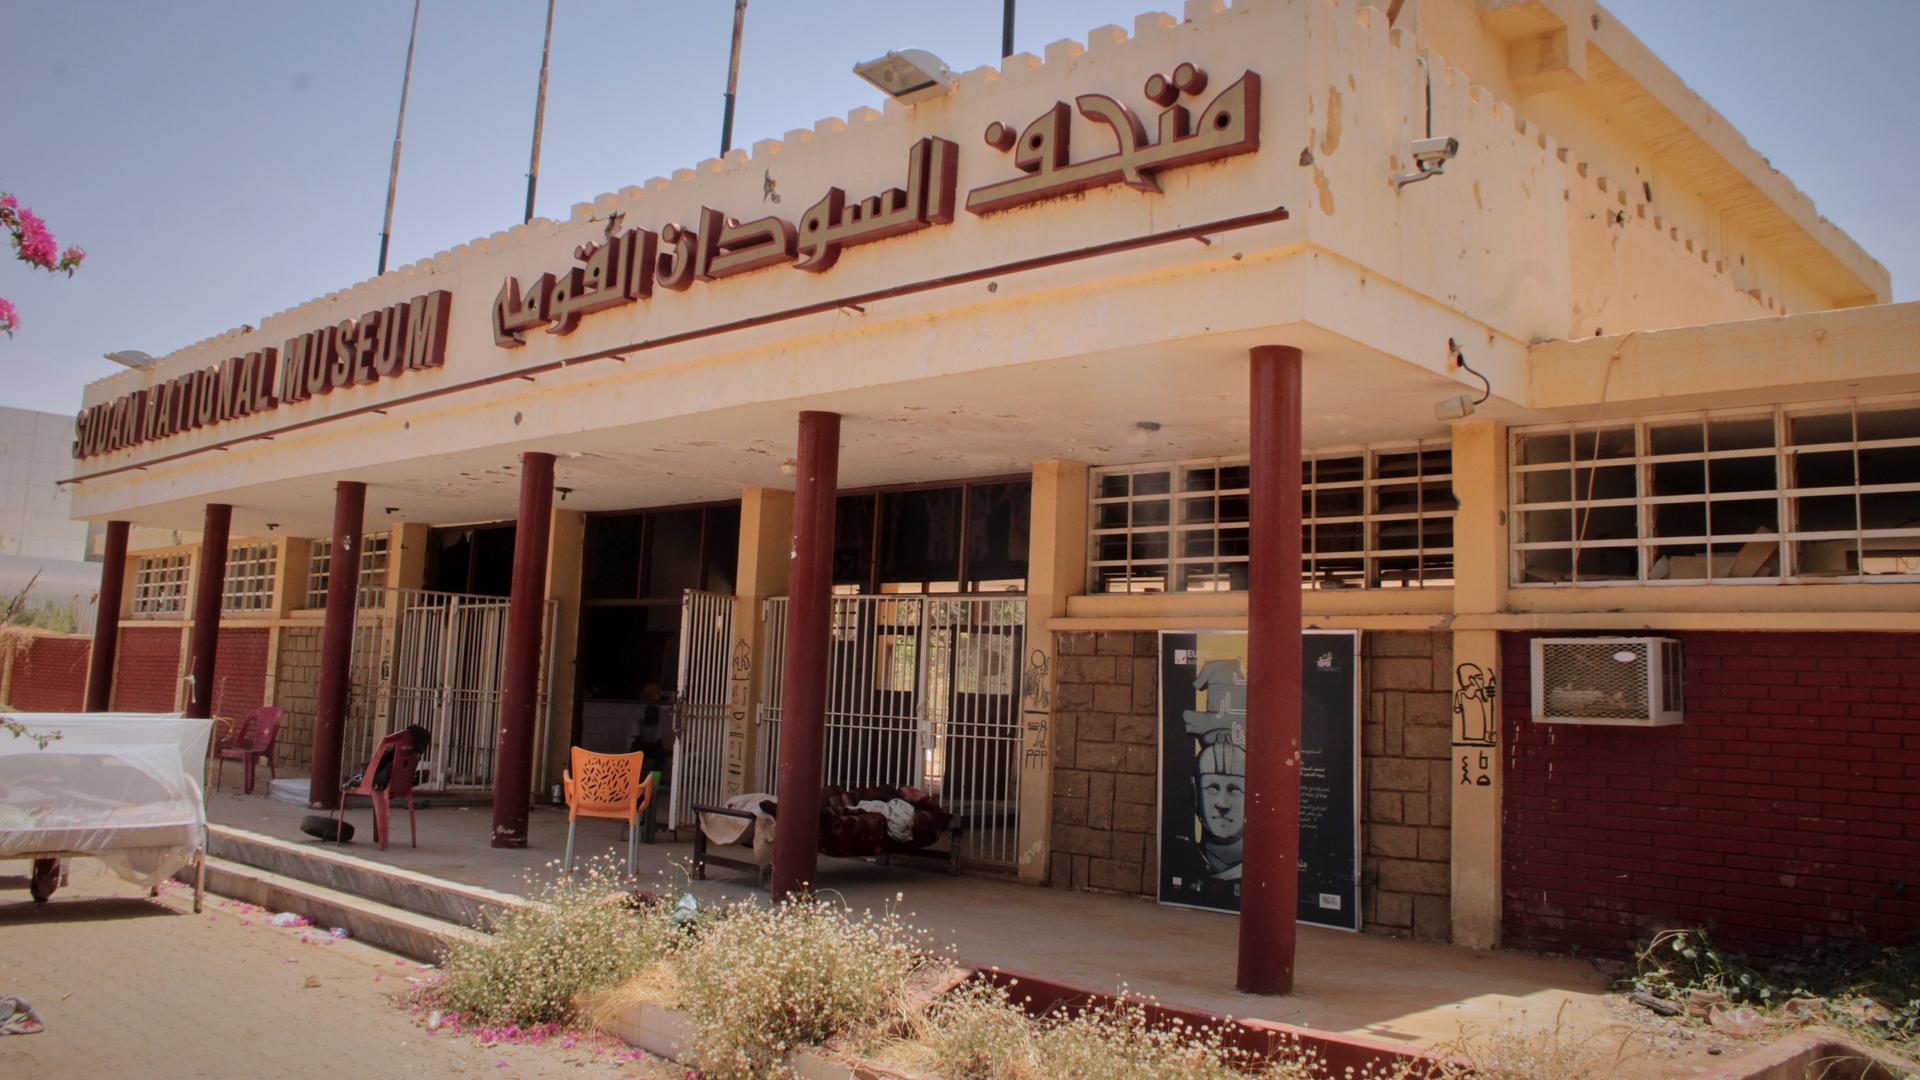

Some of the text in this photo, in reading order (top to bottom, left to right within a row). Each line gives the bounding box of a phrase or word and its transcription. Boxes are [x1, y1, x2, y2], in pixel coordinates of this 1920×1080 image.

[656, 136, 957, 292] السودان
[965, 62, 1261, 216] متحف
[72, 289, 452, 459] SUDAN NATIONAL MUSEUM
